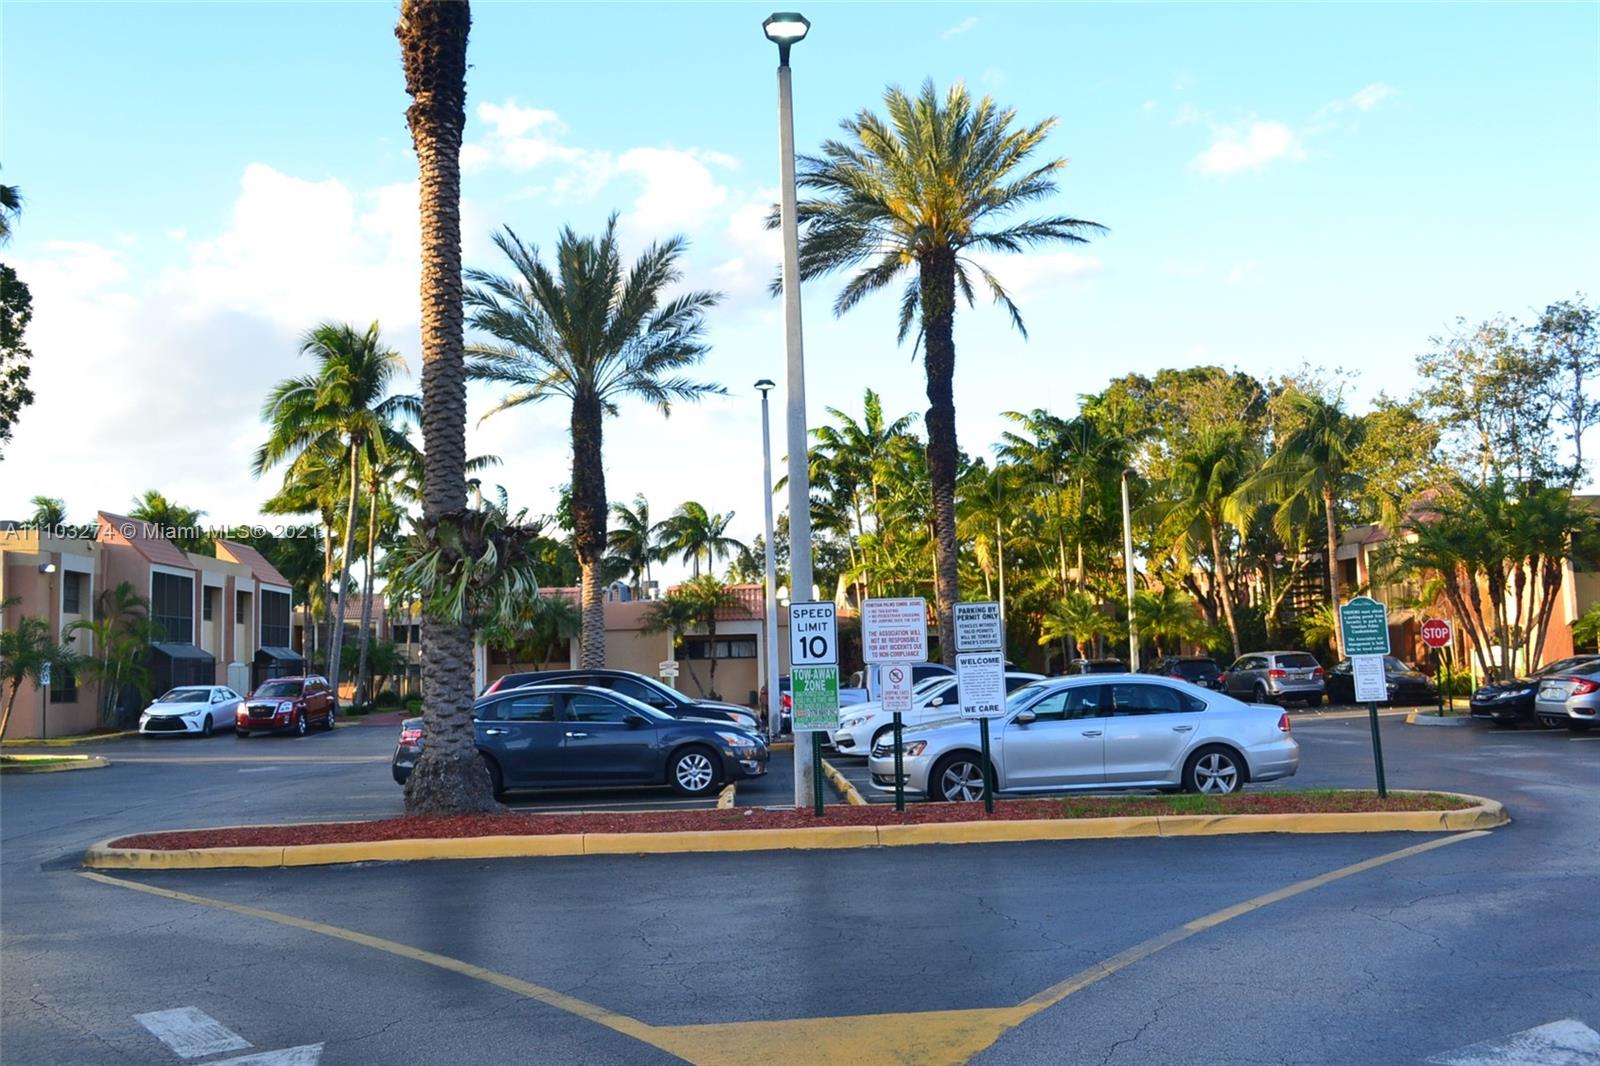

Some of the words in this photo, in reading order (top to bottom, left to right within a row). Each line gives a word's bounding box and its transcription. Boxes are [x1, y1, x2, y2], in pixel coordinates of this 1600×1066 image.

[793, 609, 832, 618] SPEED
[797, 622, 828, 632] LIMIT
[1423, 628, 1449, 639] STOP
[800, 635, 828, 658] 10
[794, 669, 835, 680] TOW-AWAY
[804, 680, 826, 691] ZONE
